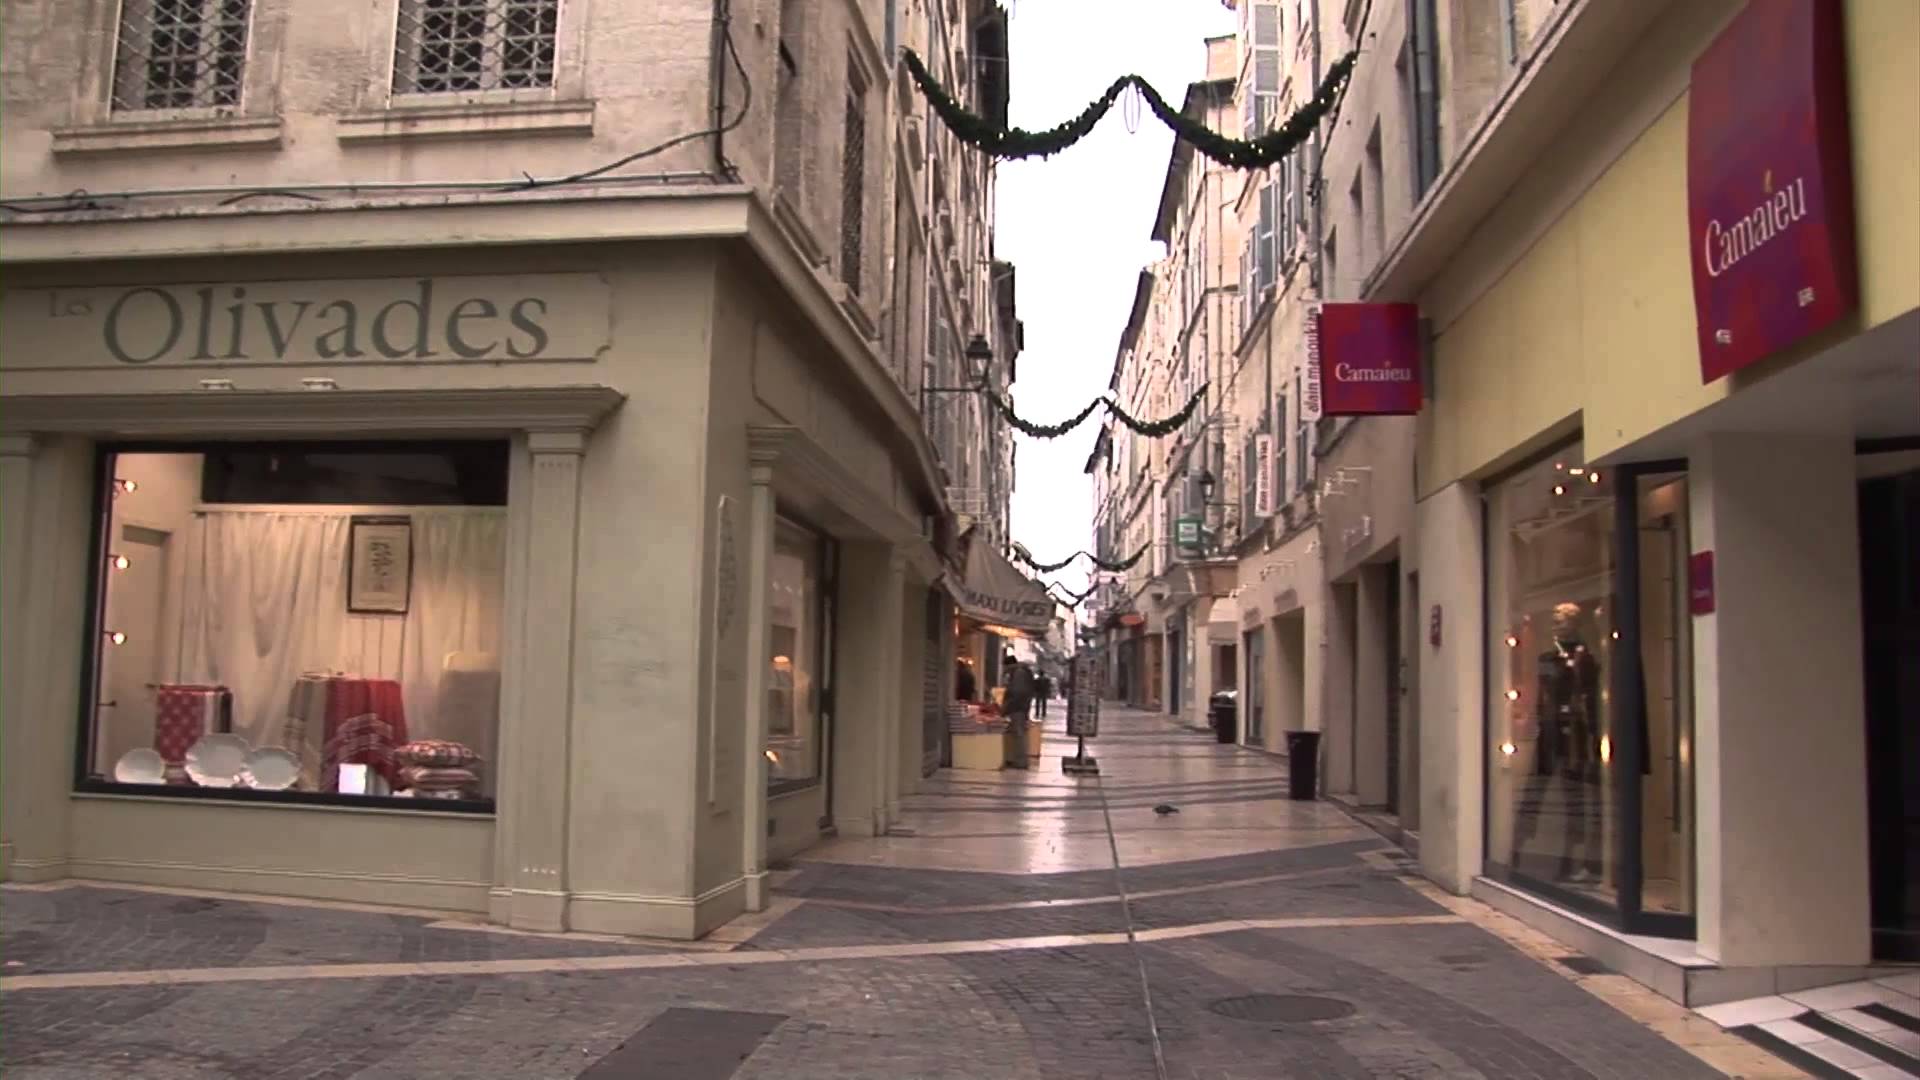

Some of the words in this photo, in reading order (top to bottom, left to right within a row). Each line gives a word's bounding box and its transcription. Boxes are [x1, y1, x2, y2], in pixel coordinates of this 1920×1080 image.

[48, 290, 93, 318] Les
[103, 279, 548, 364] Olivades
[1303, 383, 1319, 412] alain
